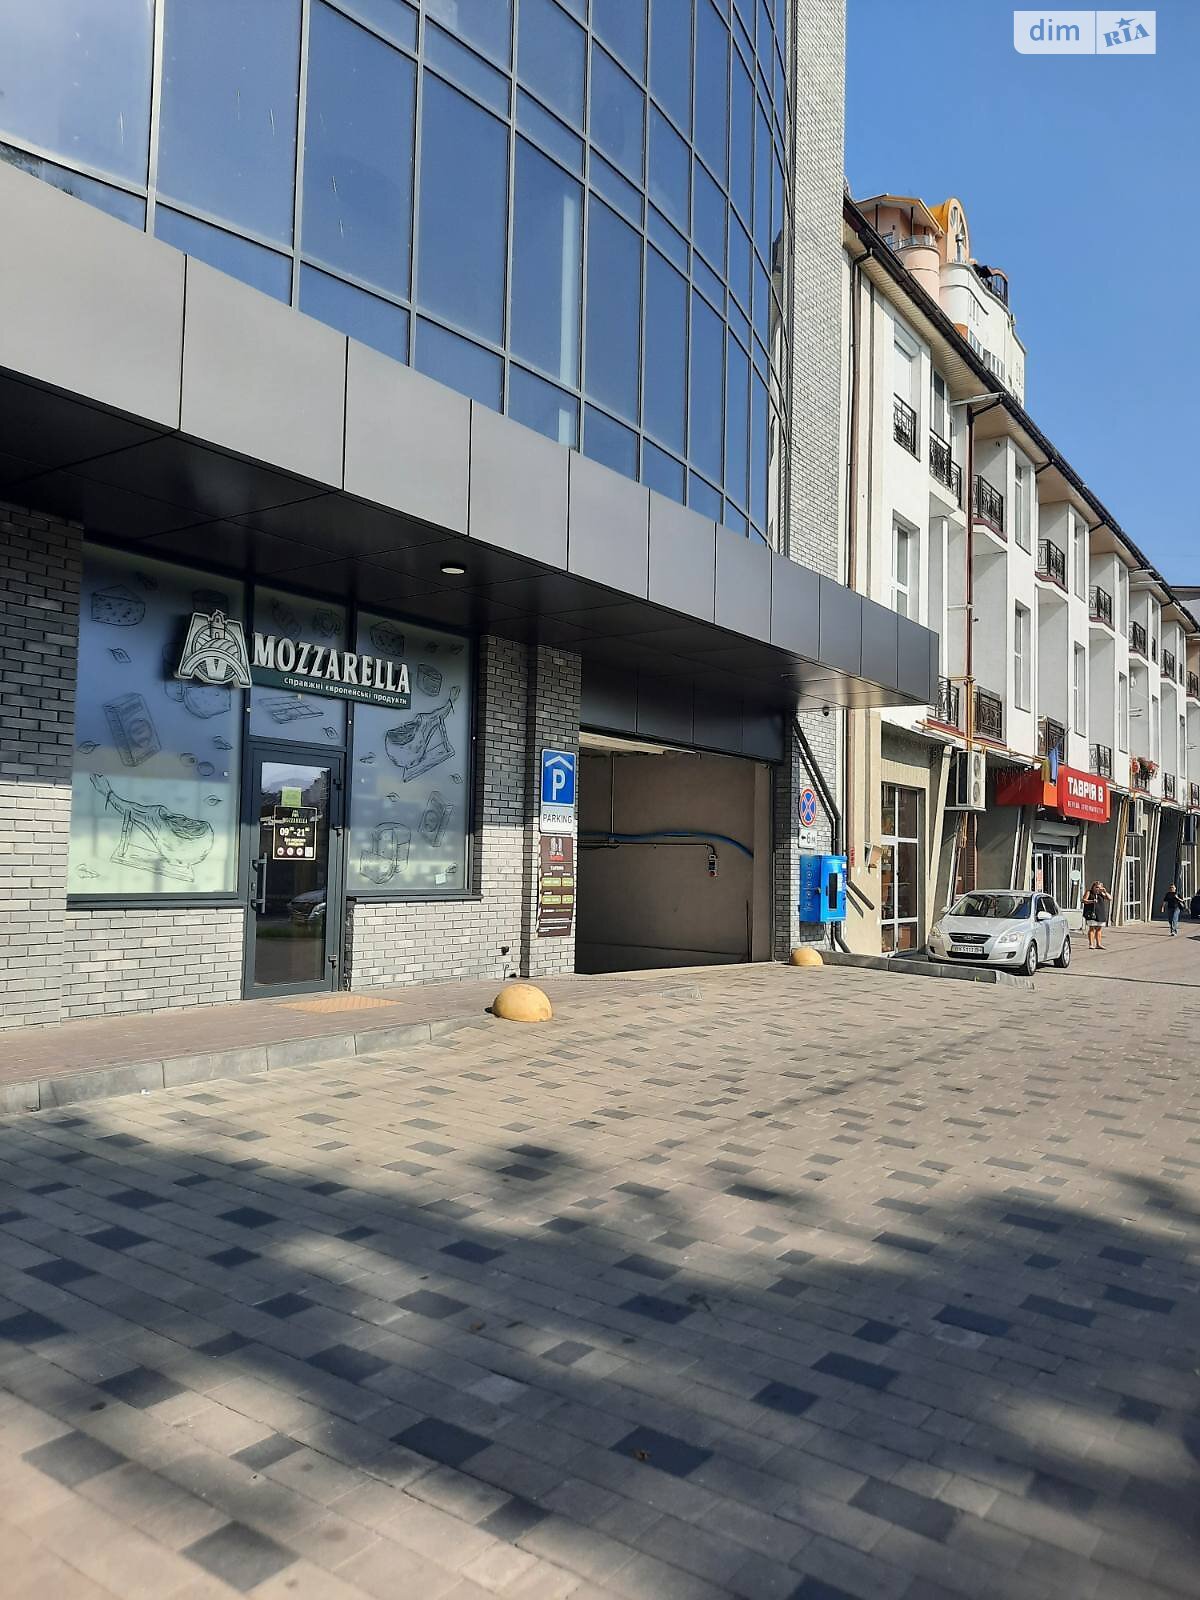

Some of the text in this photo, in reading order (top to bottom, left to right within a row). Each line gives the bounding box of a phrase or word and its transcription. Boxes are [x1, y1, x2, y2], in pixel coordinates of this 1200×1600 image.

[252, 632, 411, 693] MOZZARELLA
[552, 768, 566, 801] P
[542, 813, 573, 824] PARKING
